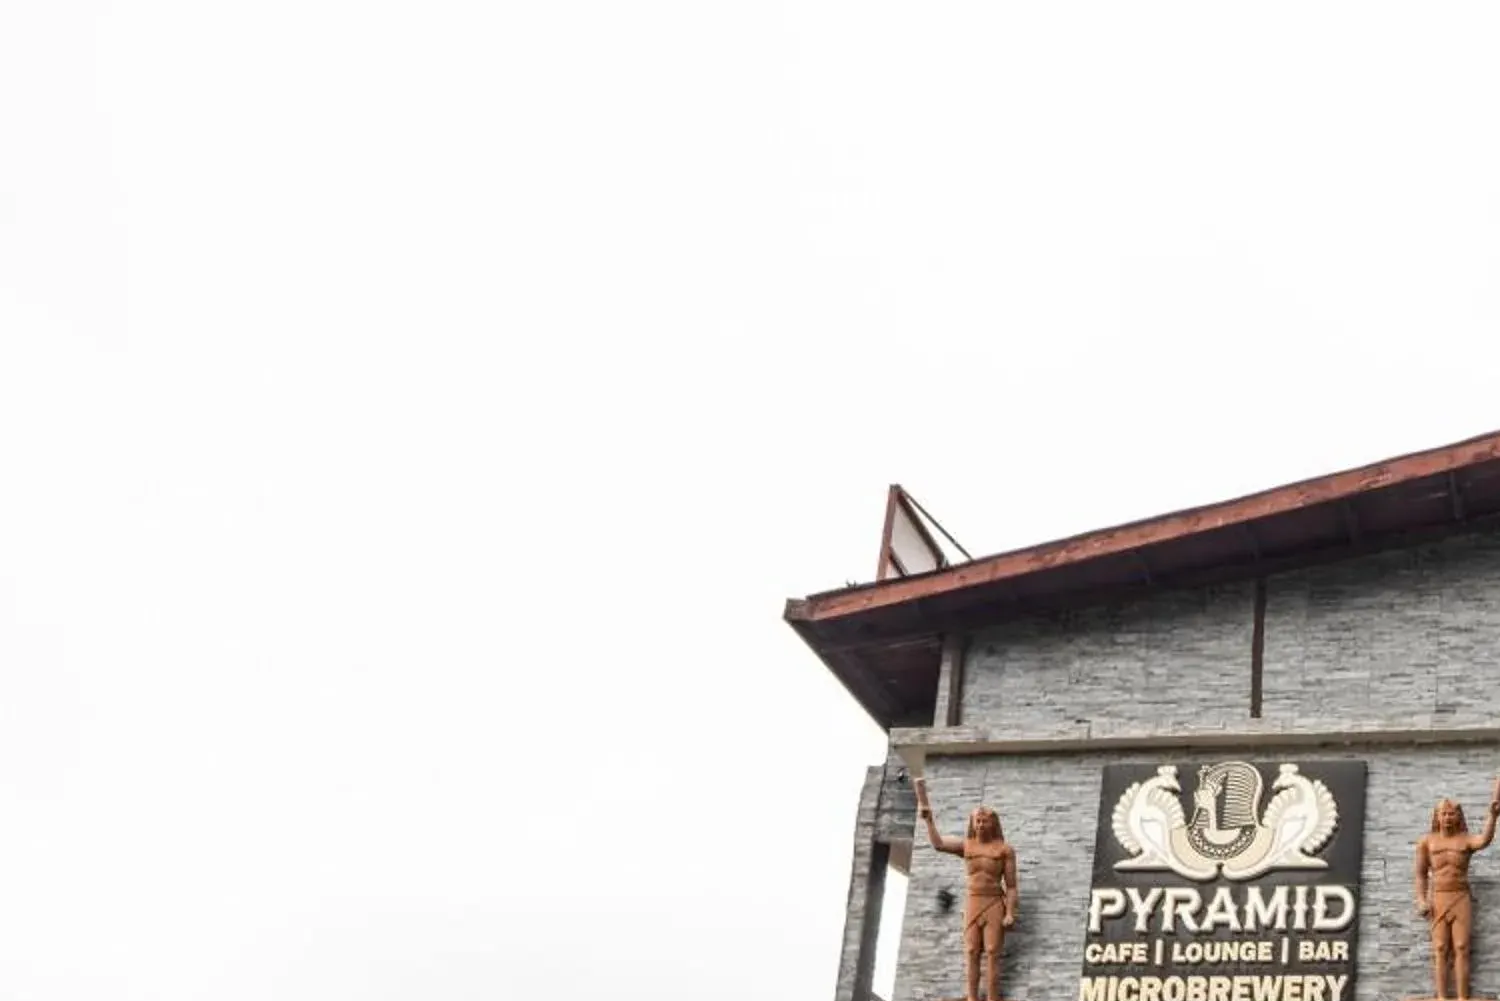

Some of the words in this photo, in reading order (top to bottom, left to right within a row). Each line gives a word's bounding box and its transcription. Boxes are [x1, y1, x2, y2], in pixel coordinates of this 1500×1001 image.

[1088, 885, 1355, 932] PYRAMID
[1086, 943, 1148, 963] CAFE
[1171, 941, 1273, 963] LOUNGE
[1299, 941, 1349, 962] BAR
